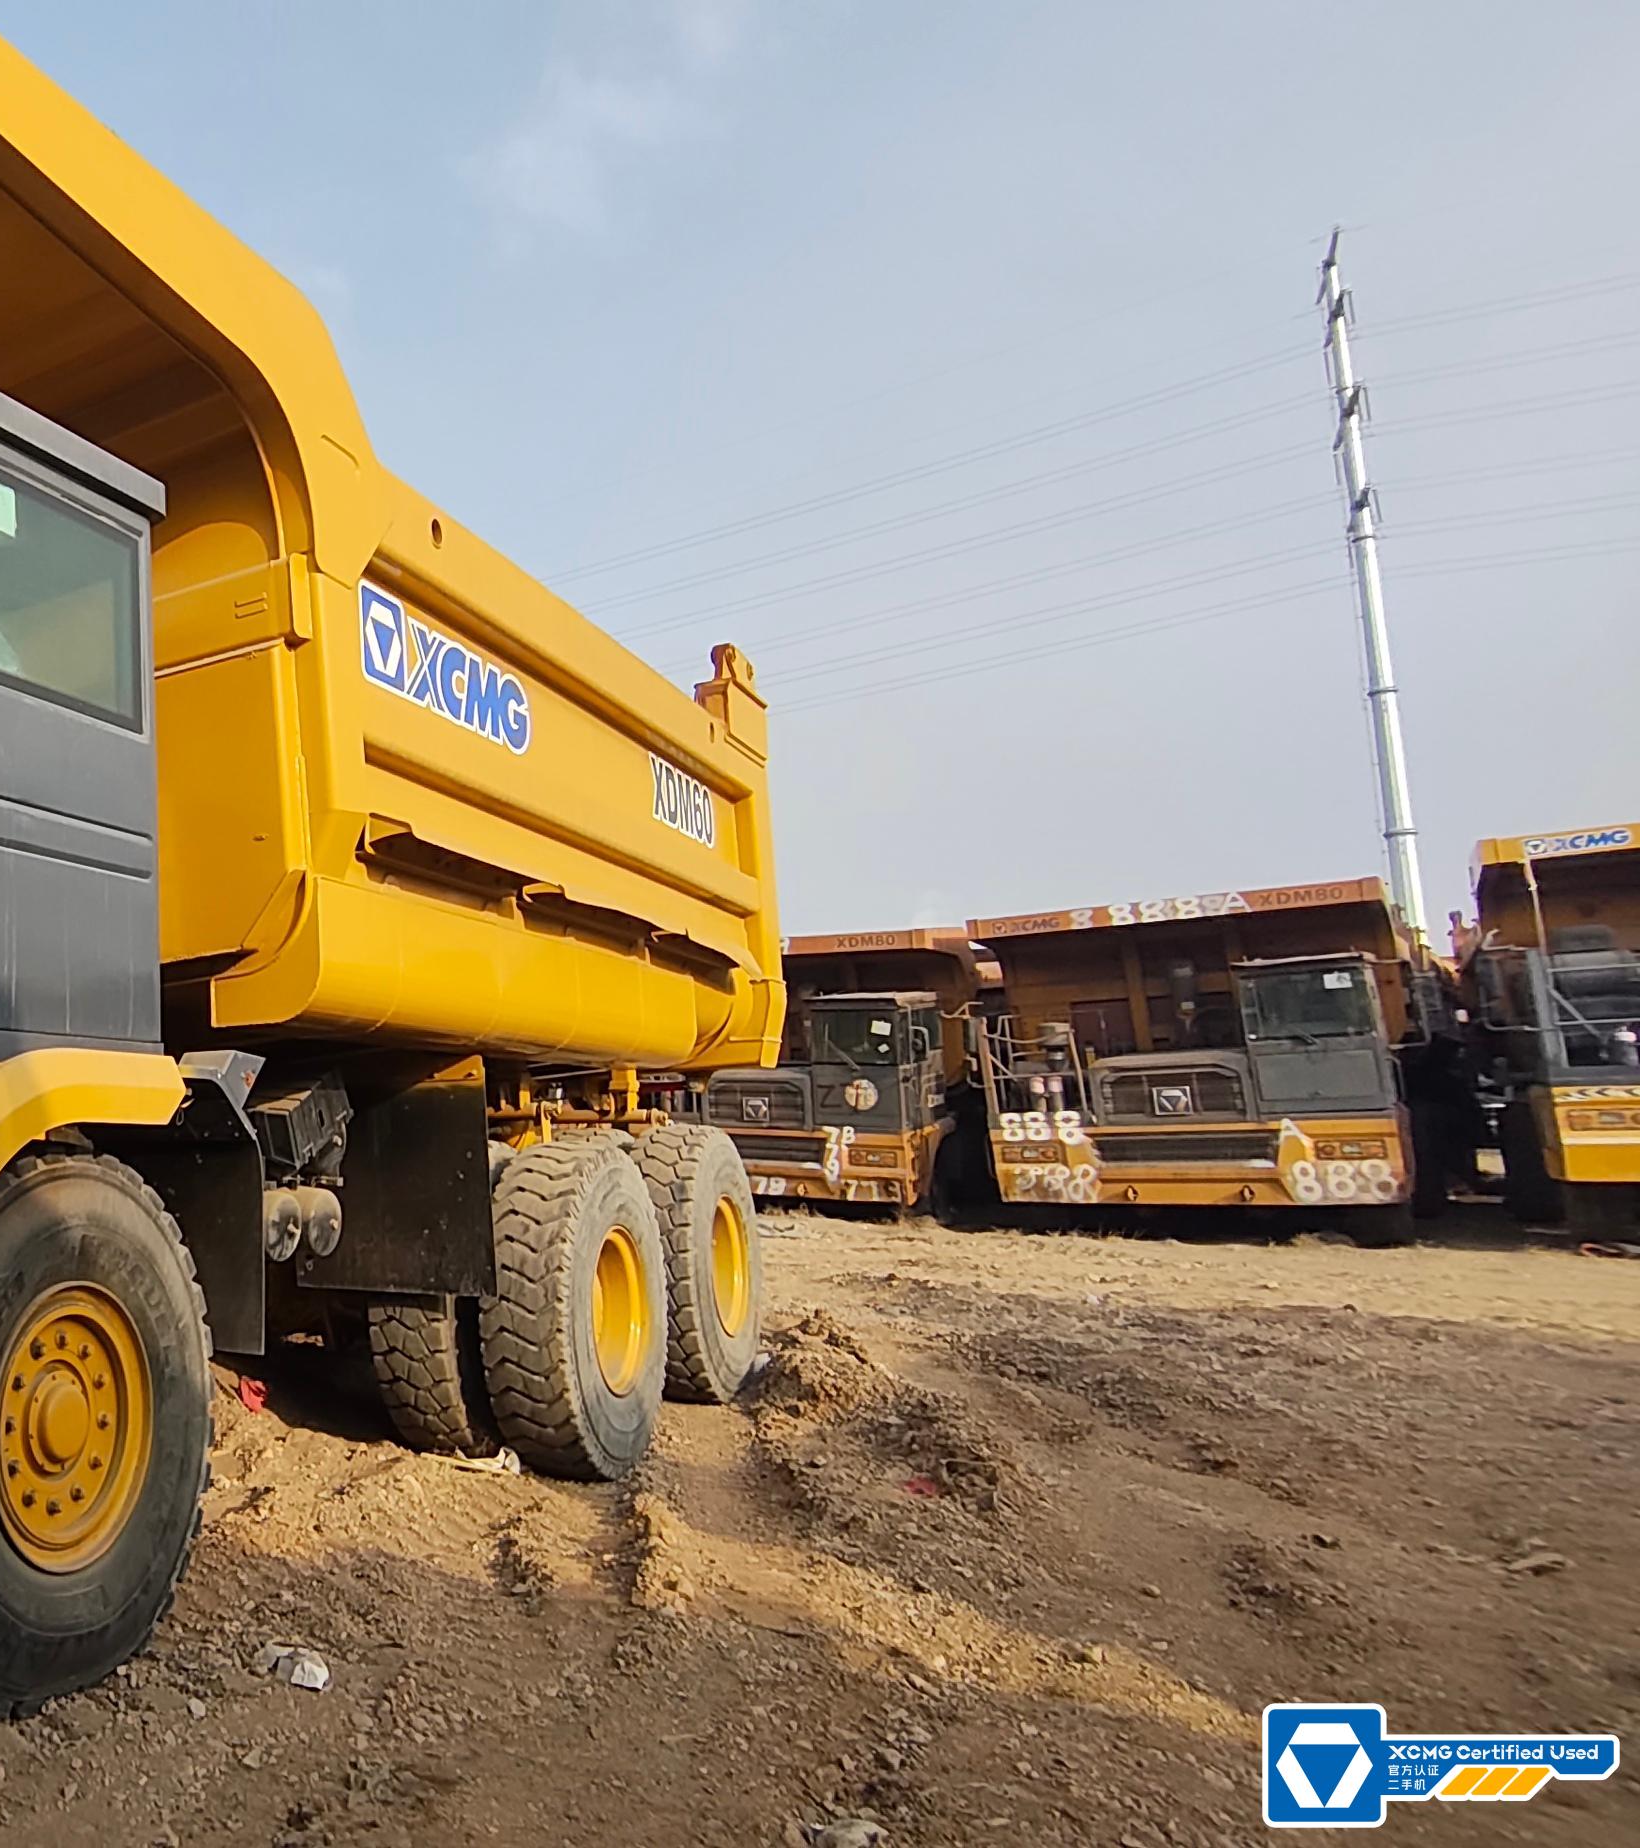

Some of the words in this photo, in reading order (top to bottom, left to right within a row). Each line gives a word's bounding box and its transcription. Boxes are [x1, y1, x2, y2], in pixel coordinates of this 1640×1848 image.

[406, 619, 529, 753] XCMG
[649, 754, 713, 846] XDM60
[1551, 829, 1630, 851] XCMG
[1010, 917, 1060, 934] XCMG
